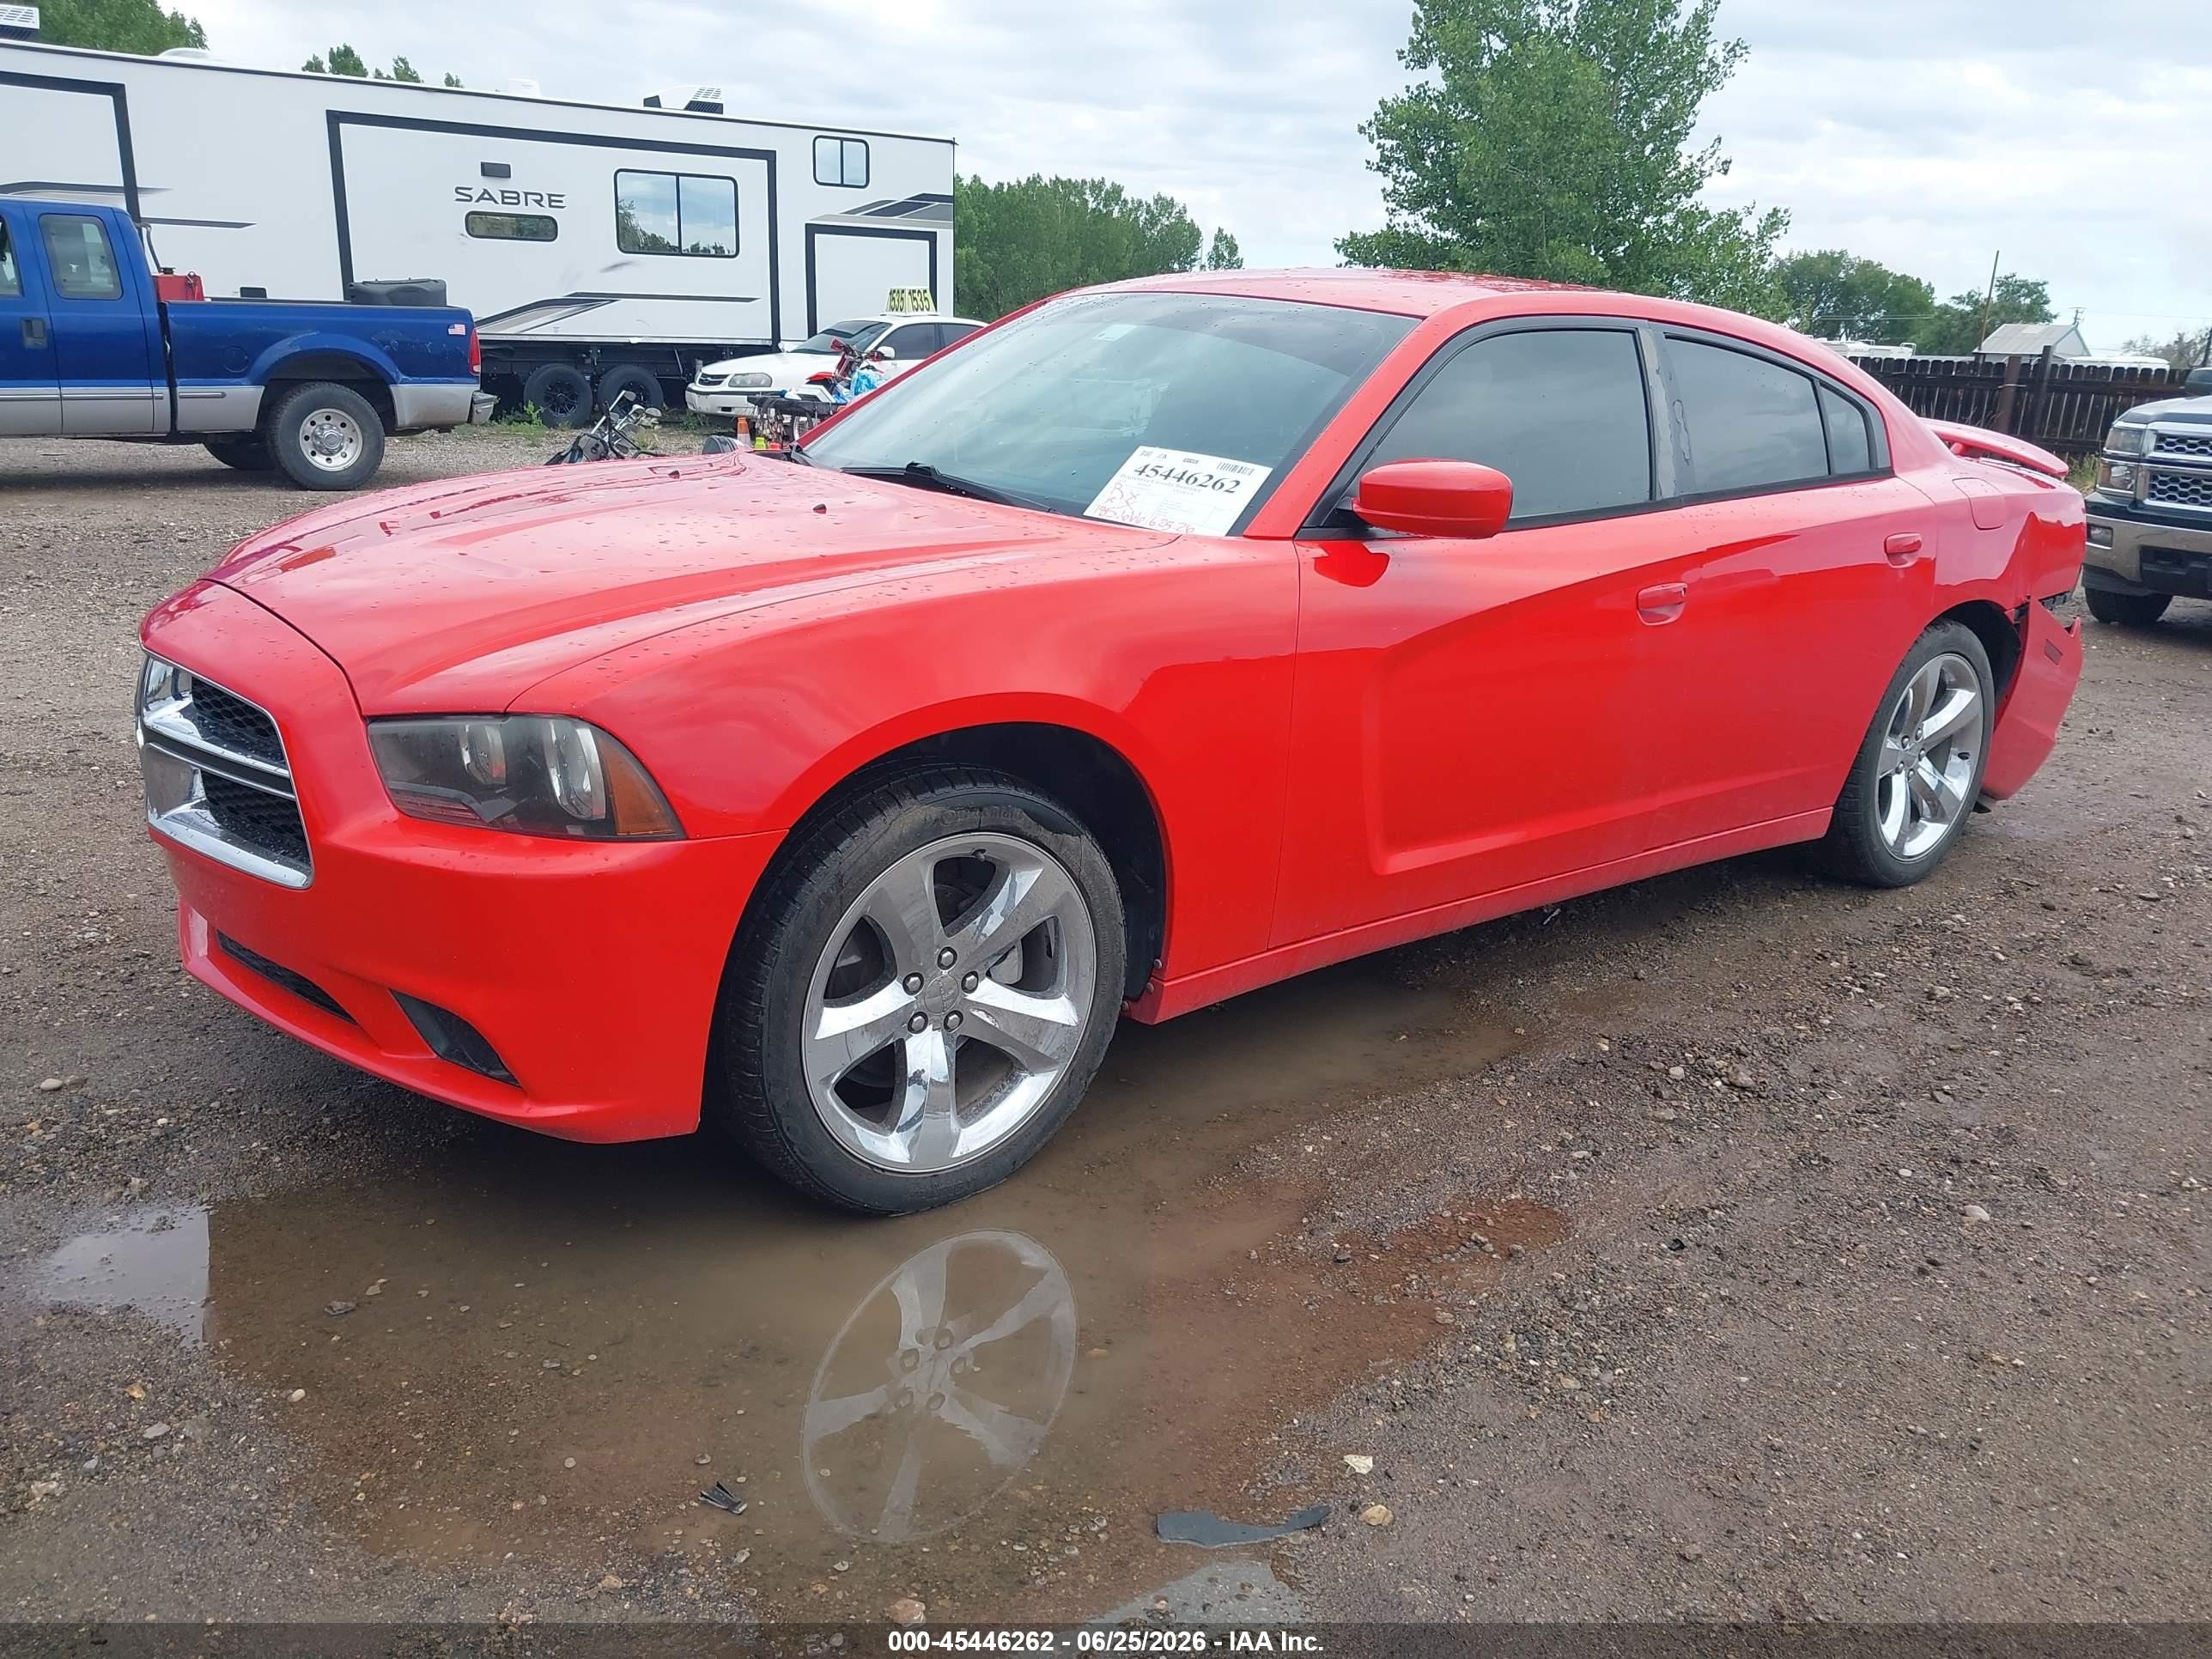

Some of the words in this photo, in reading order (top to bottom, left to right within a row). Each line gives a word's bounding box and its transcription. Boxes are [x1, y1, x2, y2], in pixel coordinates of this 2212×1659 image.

[454, 186, 567, 209] SABRE
[889, 289, 905, 312] 1535
[908, 289, 930, 312] 1535
[1133, 464, 1241, 494] 45446262
